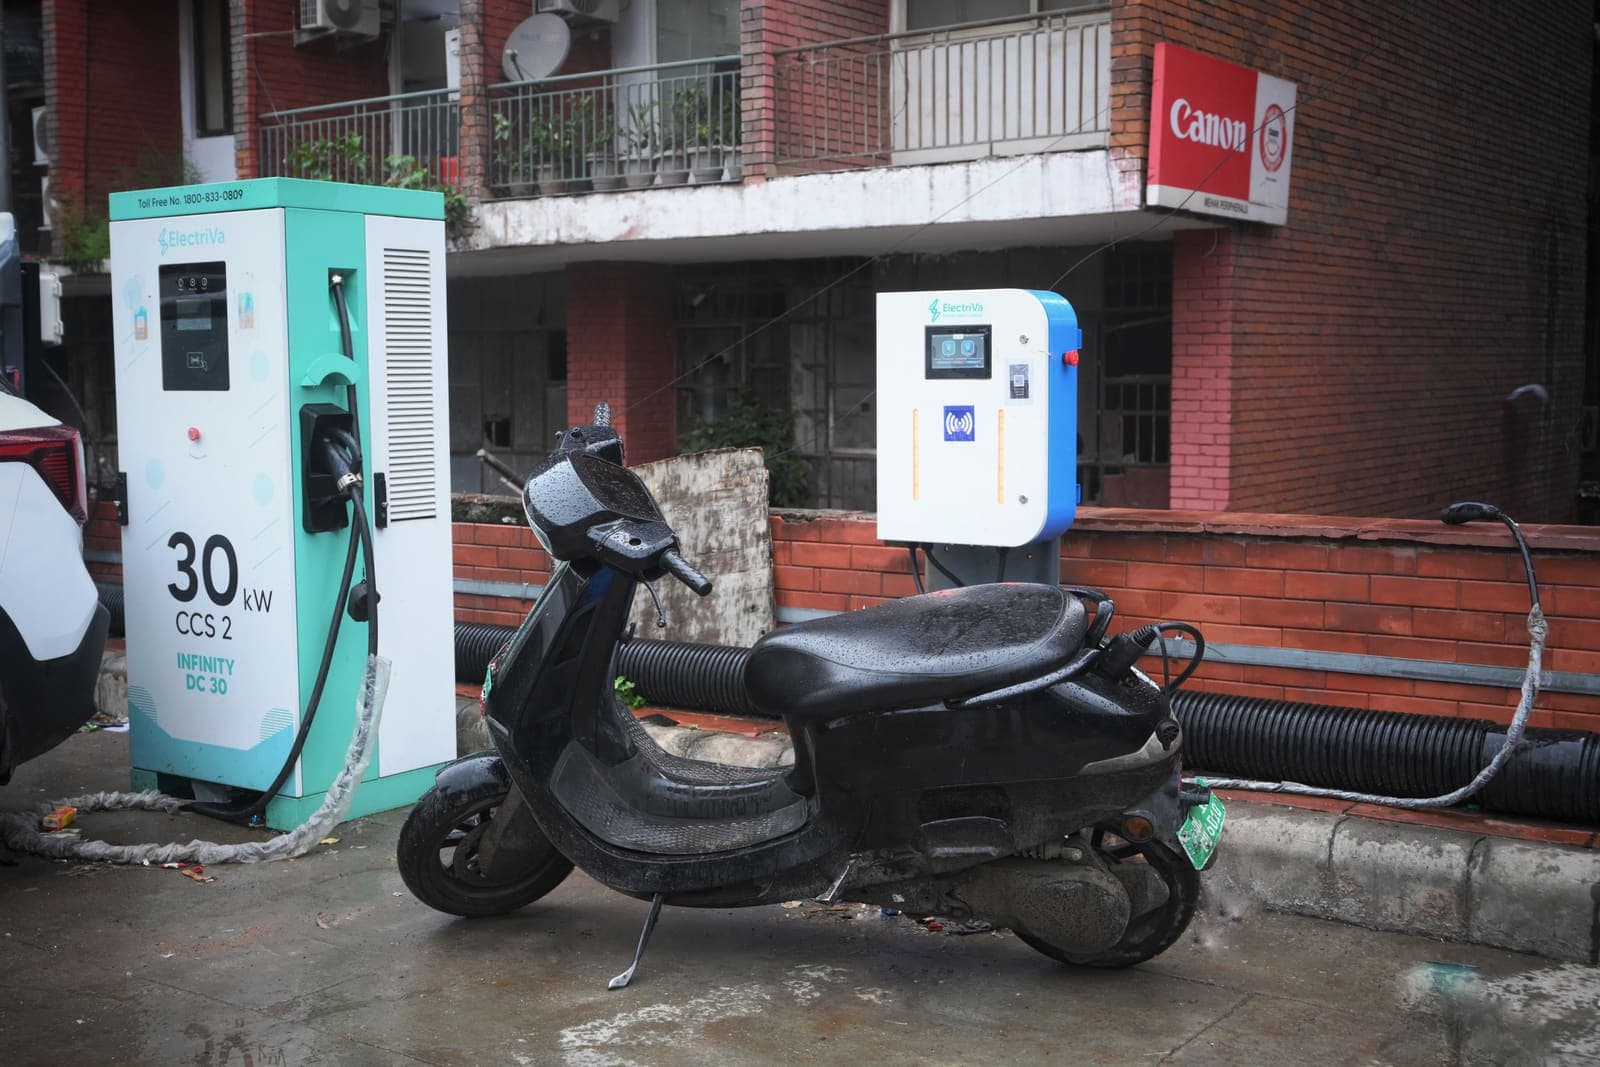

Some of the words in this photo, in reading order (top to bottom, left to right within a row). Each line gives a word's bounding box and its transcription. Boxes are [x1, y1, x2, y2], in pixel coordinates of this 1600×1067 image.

[1170, 98, 1247, 153] Canon
[138, 198, 151, 208] Toll
[151, 196, 168, 207] Free
[169, 194, 182, 205] No.
[183, 189, 244, 204] 1800-833-0809
[168, 227, 225, 248] ElectriVa
[943, 303, 984, 313] ElectriVa
[167, 531, 239, 606] 30
[243, 588, 273, 613] kW
[175, 611, 216, 638] CCS
[222, 615, 233, 640] 2
[176, 652, 236, 676] INFINITY
[186, 674, 206, 692] DC
[210, 676, 228, 695] 30
